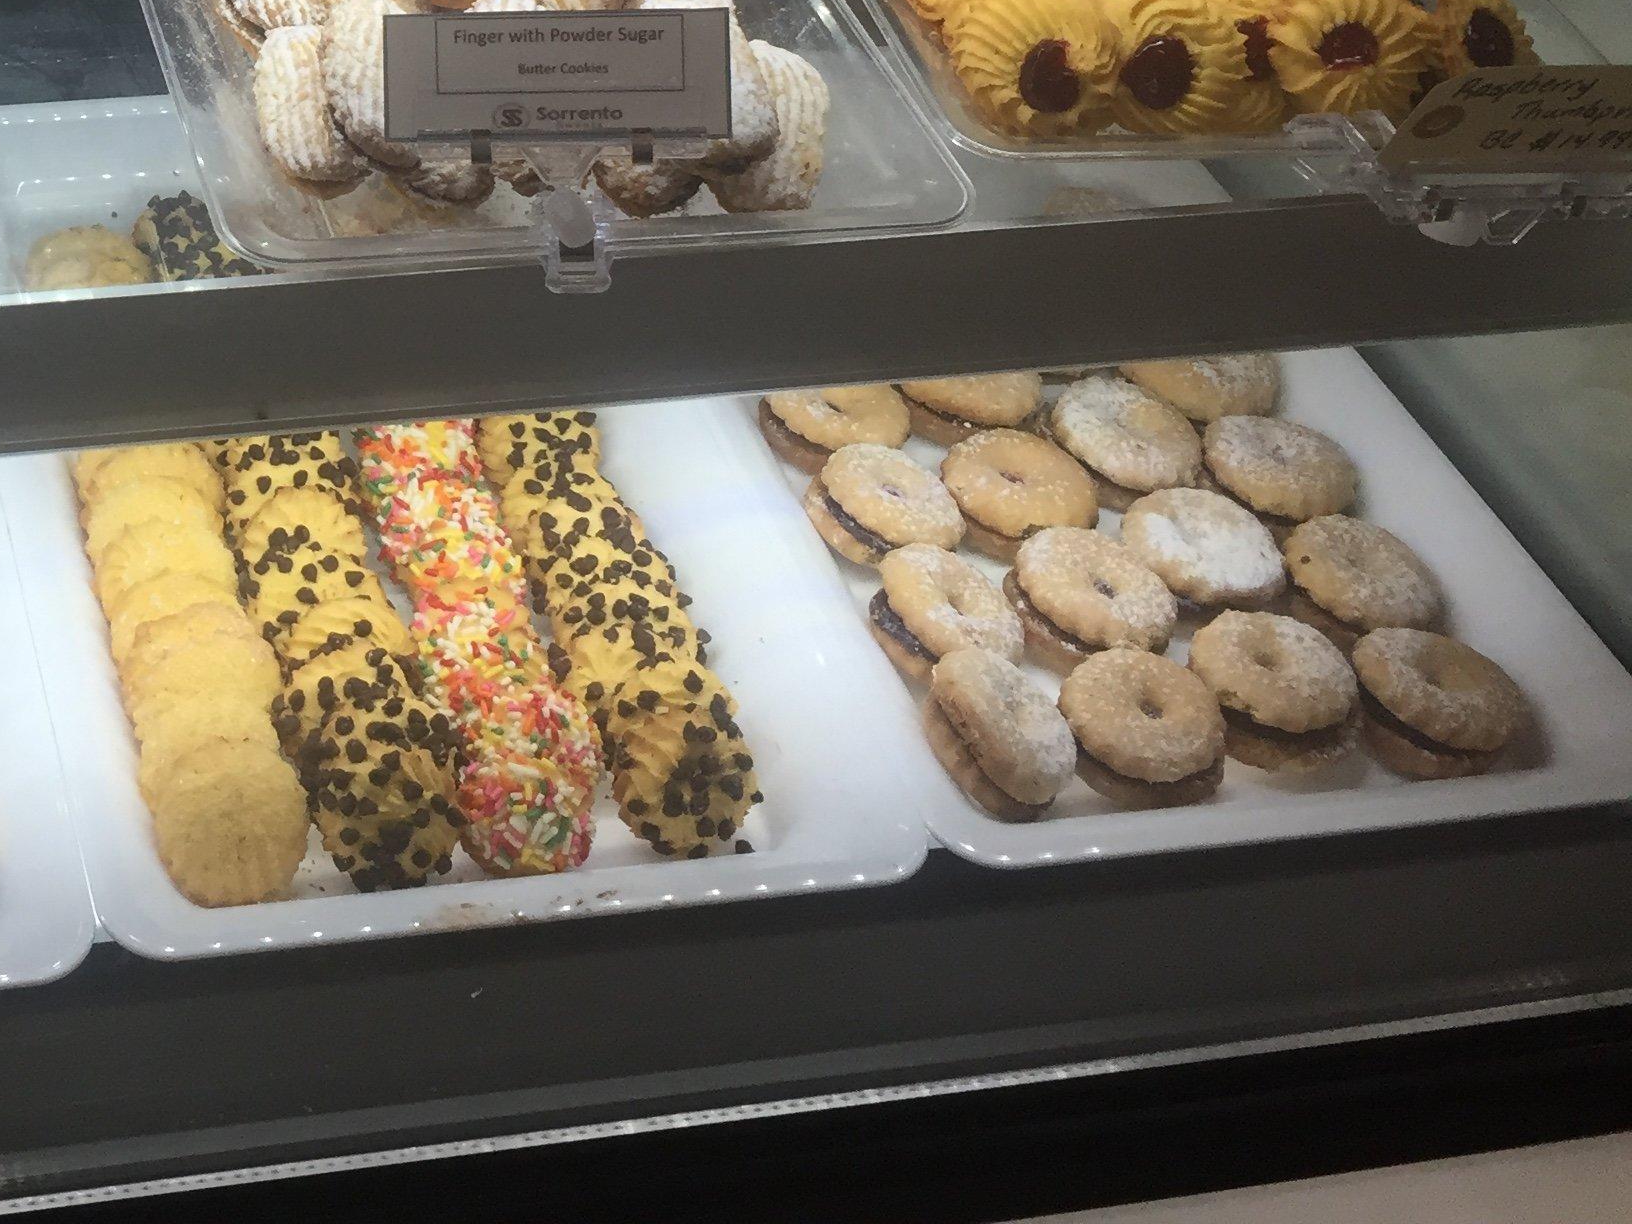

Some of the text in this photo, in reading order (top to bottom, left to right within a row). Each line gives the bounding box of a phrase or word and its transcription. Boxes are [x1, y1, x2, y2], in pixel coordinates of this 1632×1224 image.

[453, 26, 664, 48] Finger with Powder Sugar
[518, 61, 610, 76] Butter Cookies
[536, 105, 624, 122] Sorrento
